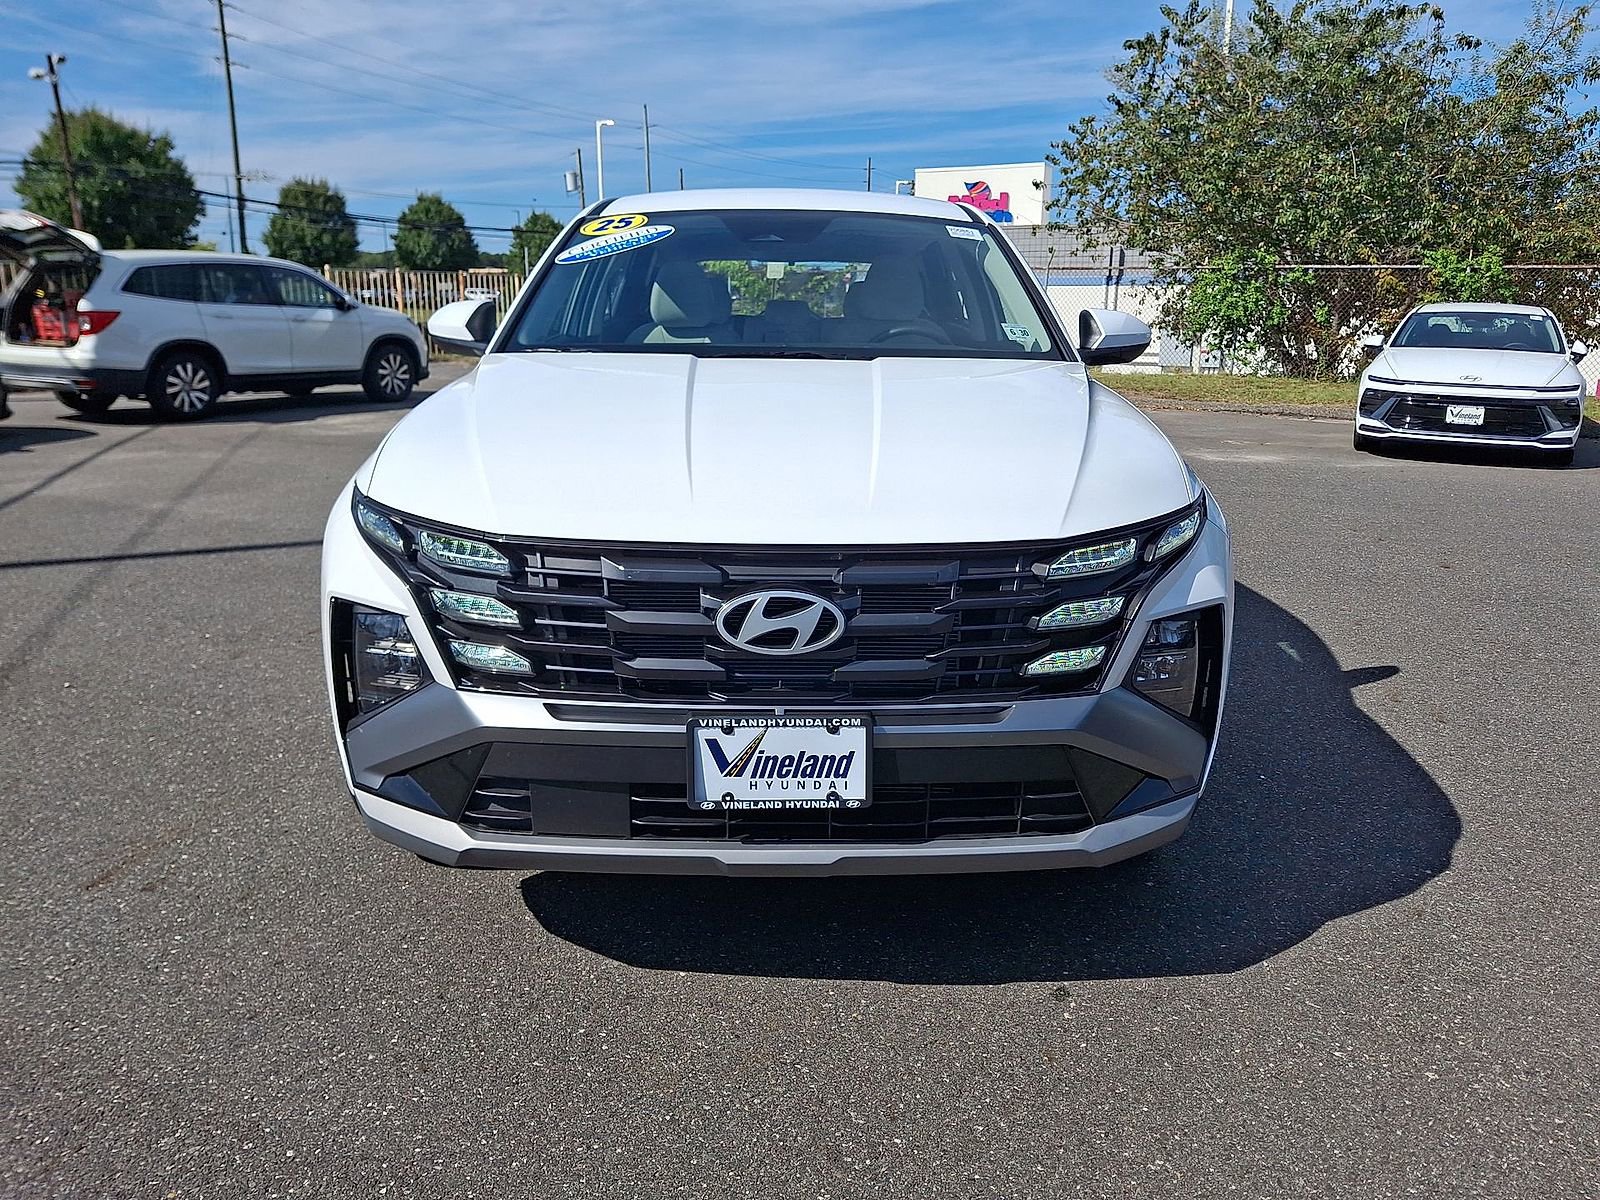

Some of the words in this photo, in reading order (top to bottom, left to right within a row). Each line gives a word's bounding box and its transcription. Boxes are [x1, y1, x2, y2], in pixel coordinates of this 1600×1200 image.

[591, 216, 637, 233] 25
[699, 718, 861, 727] VINELANDHYUNDAI.COM
[704, 727, 856, 779] Vineland
[749, 780, 848, 791] HYUNDAI
[721, 801, 782, 810] VINELAND
[786, 800, 840, 809] HYUNDAI
